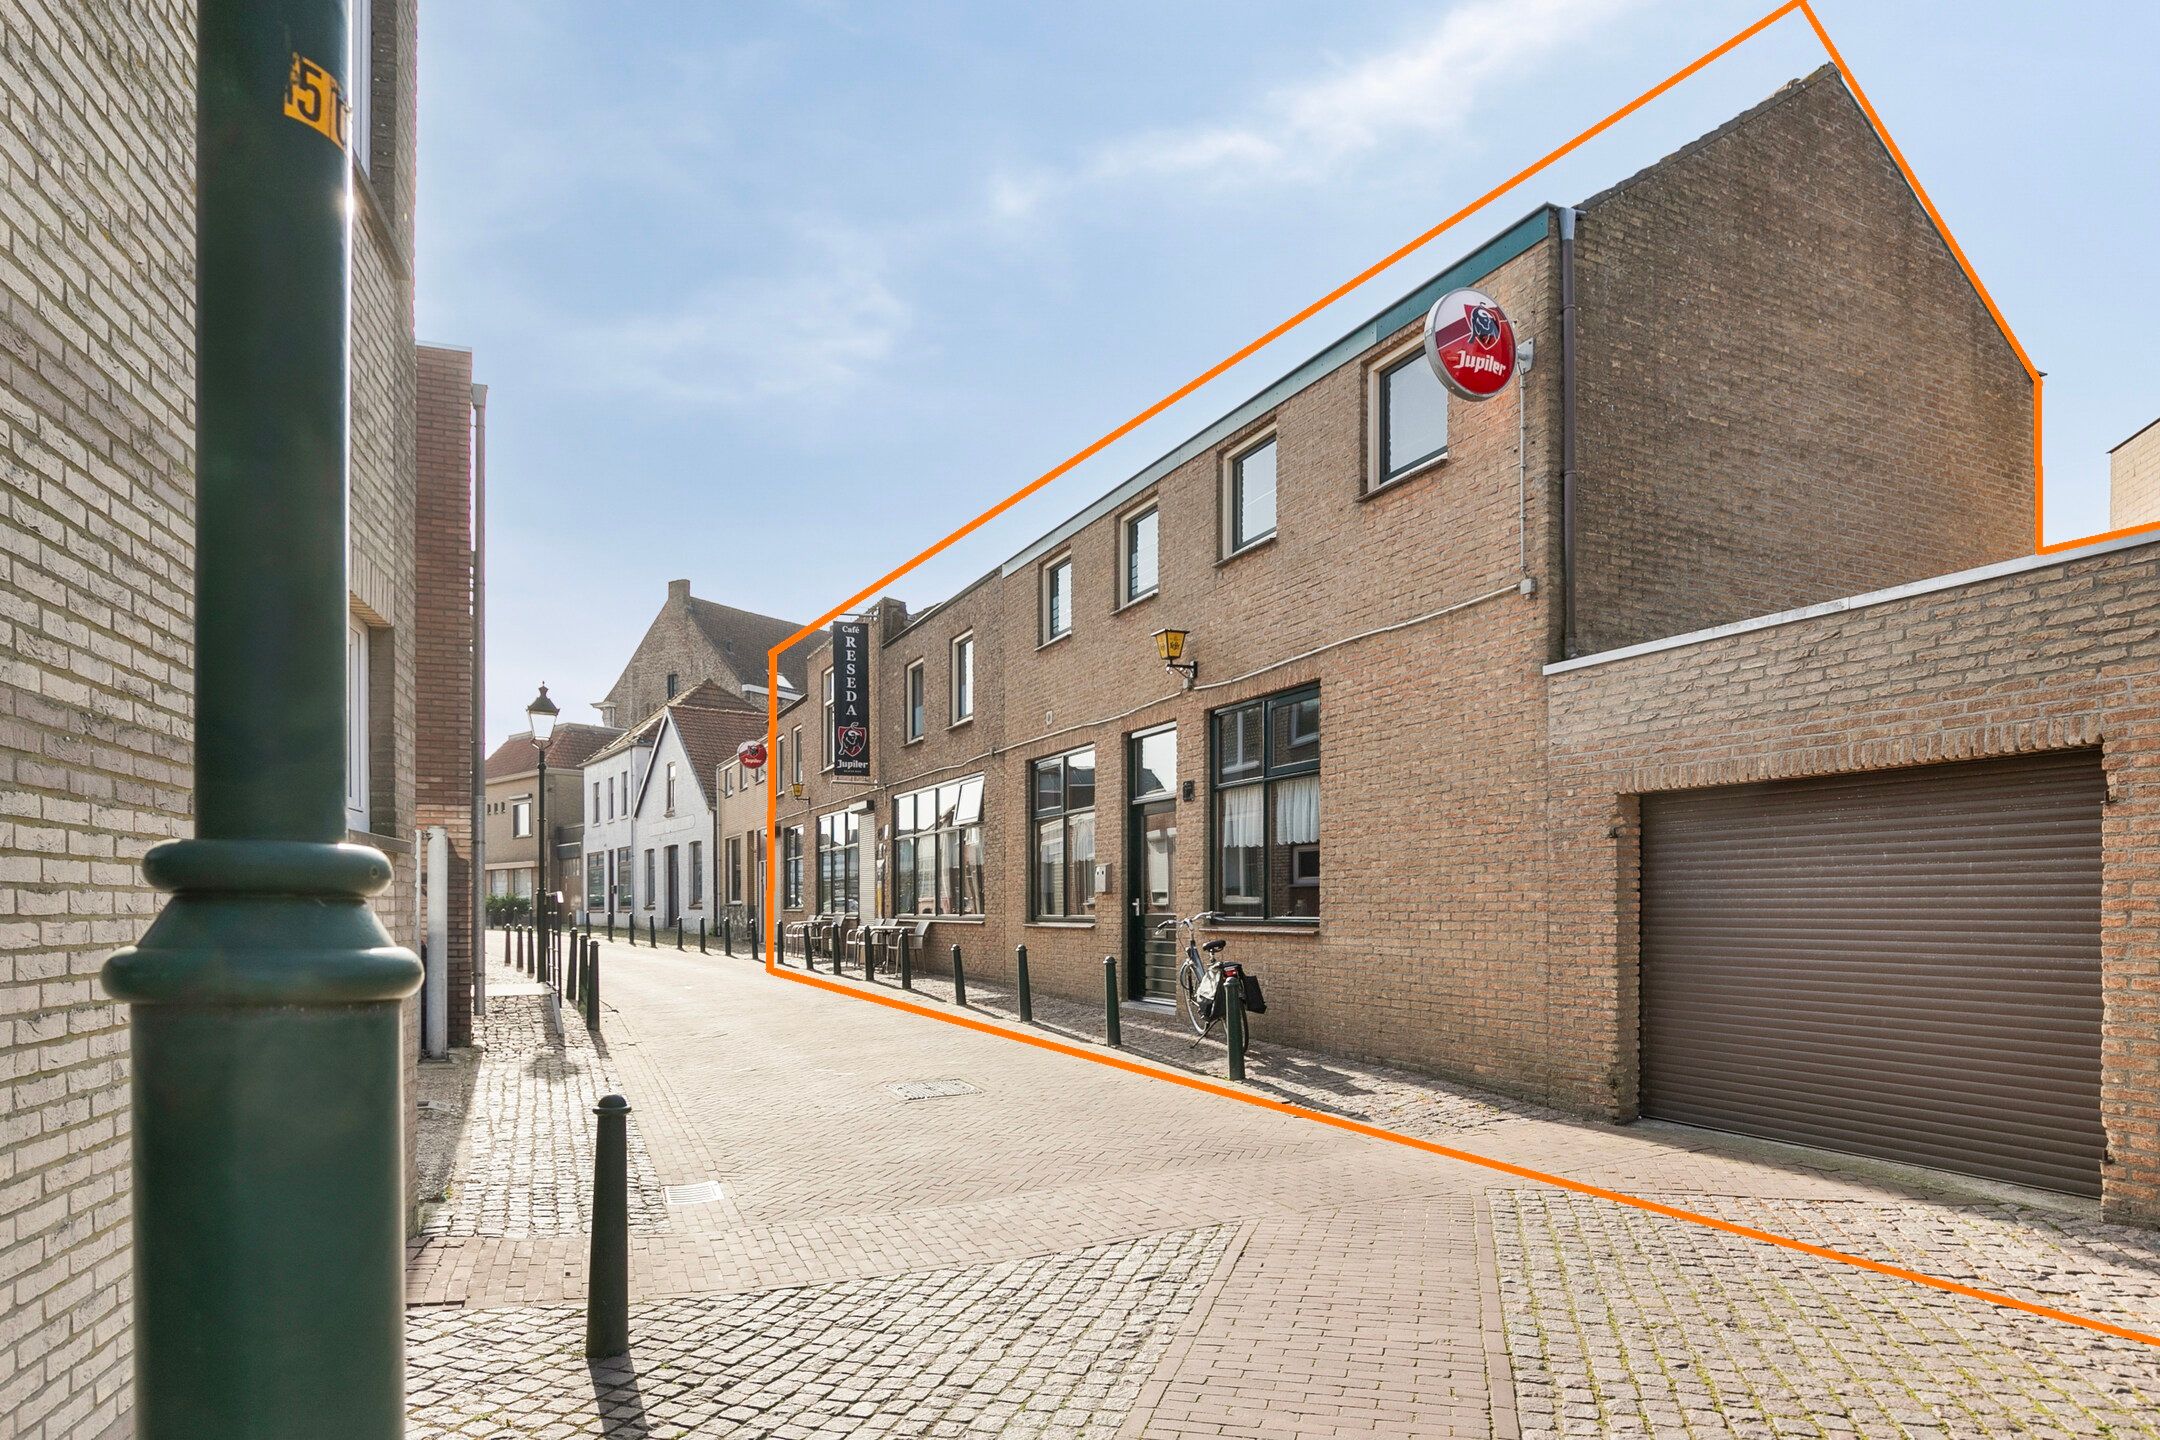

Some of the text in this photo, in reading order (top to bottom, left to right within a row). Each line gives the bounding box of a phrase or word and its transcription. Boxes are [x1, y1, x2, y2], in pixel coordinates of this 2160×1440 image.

[1453, 350, 1506, 376] Jupiler
[842, 625, 859, 633] Café
[845, 636, 857, 715] RESEDA
[837, 760, 868, 769] Jupiler
